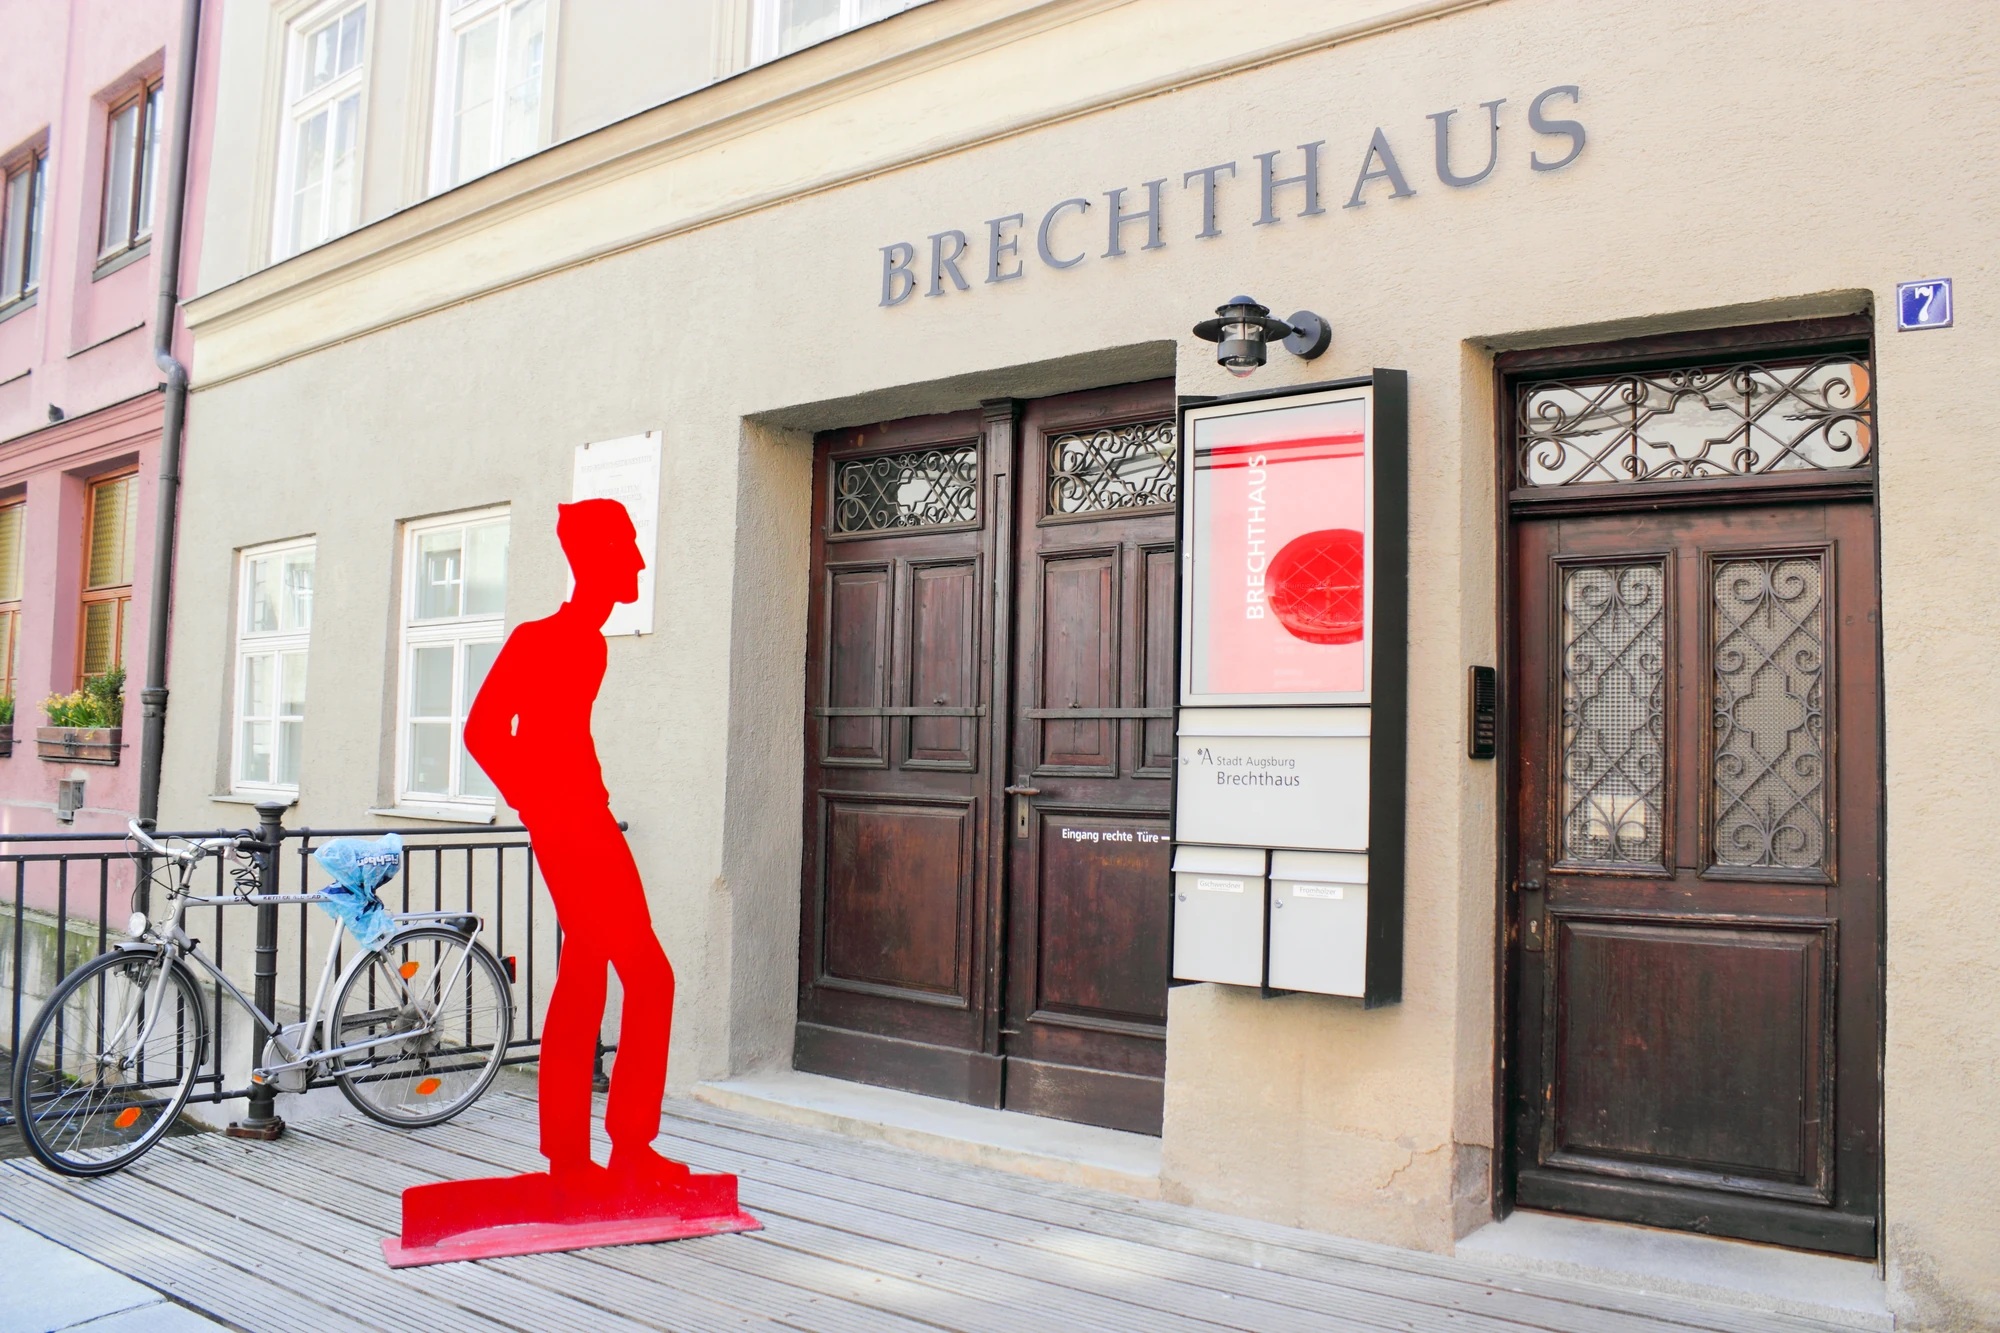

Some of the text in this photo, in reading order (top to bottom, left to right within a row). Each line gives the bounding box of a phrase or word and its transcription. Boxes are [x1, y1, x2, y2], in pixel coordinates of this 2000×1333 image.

[878, 85, 1588, 307] BRECHTHAUS
[1914, 286, 1934, 321] 7
[1246, 454, 1267, 620] BRECHTHAUS
[1216, 756, 1296, 770] Stadt Augsburg
[1216, 771, 1301, 787] Brechthaus
[1061, 828, 1159, 843] Eingang rechte Türe
